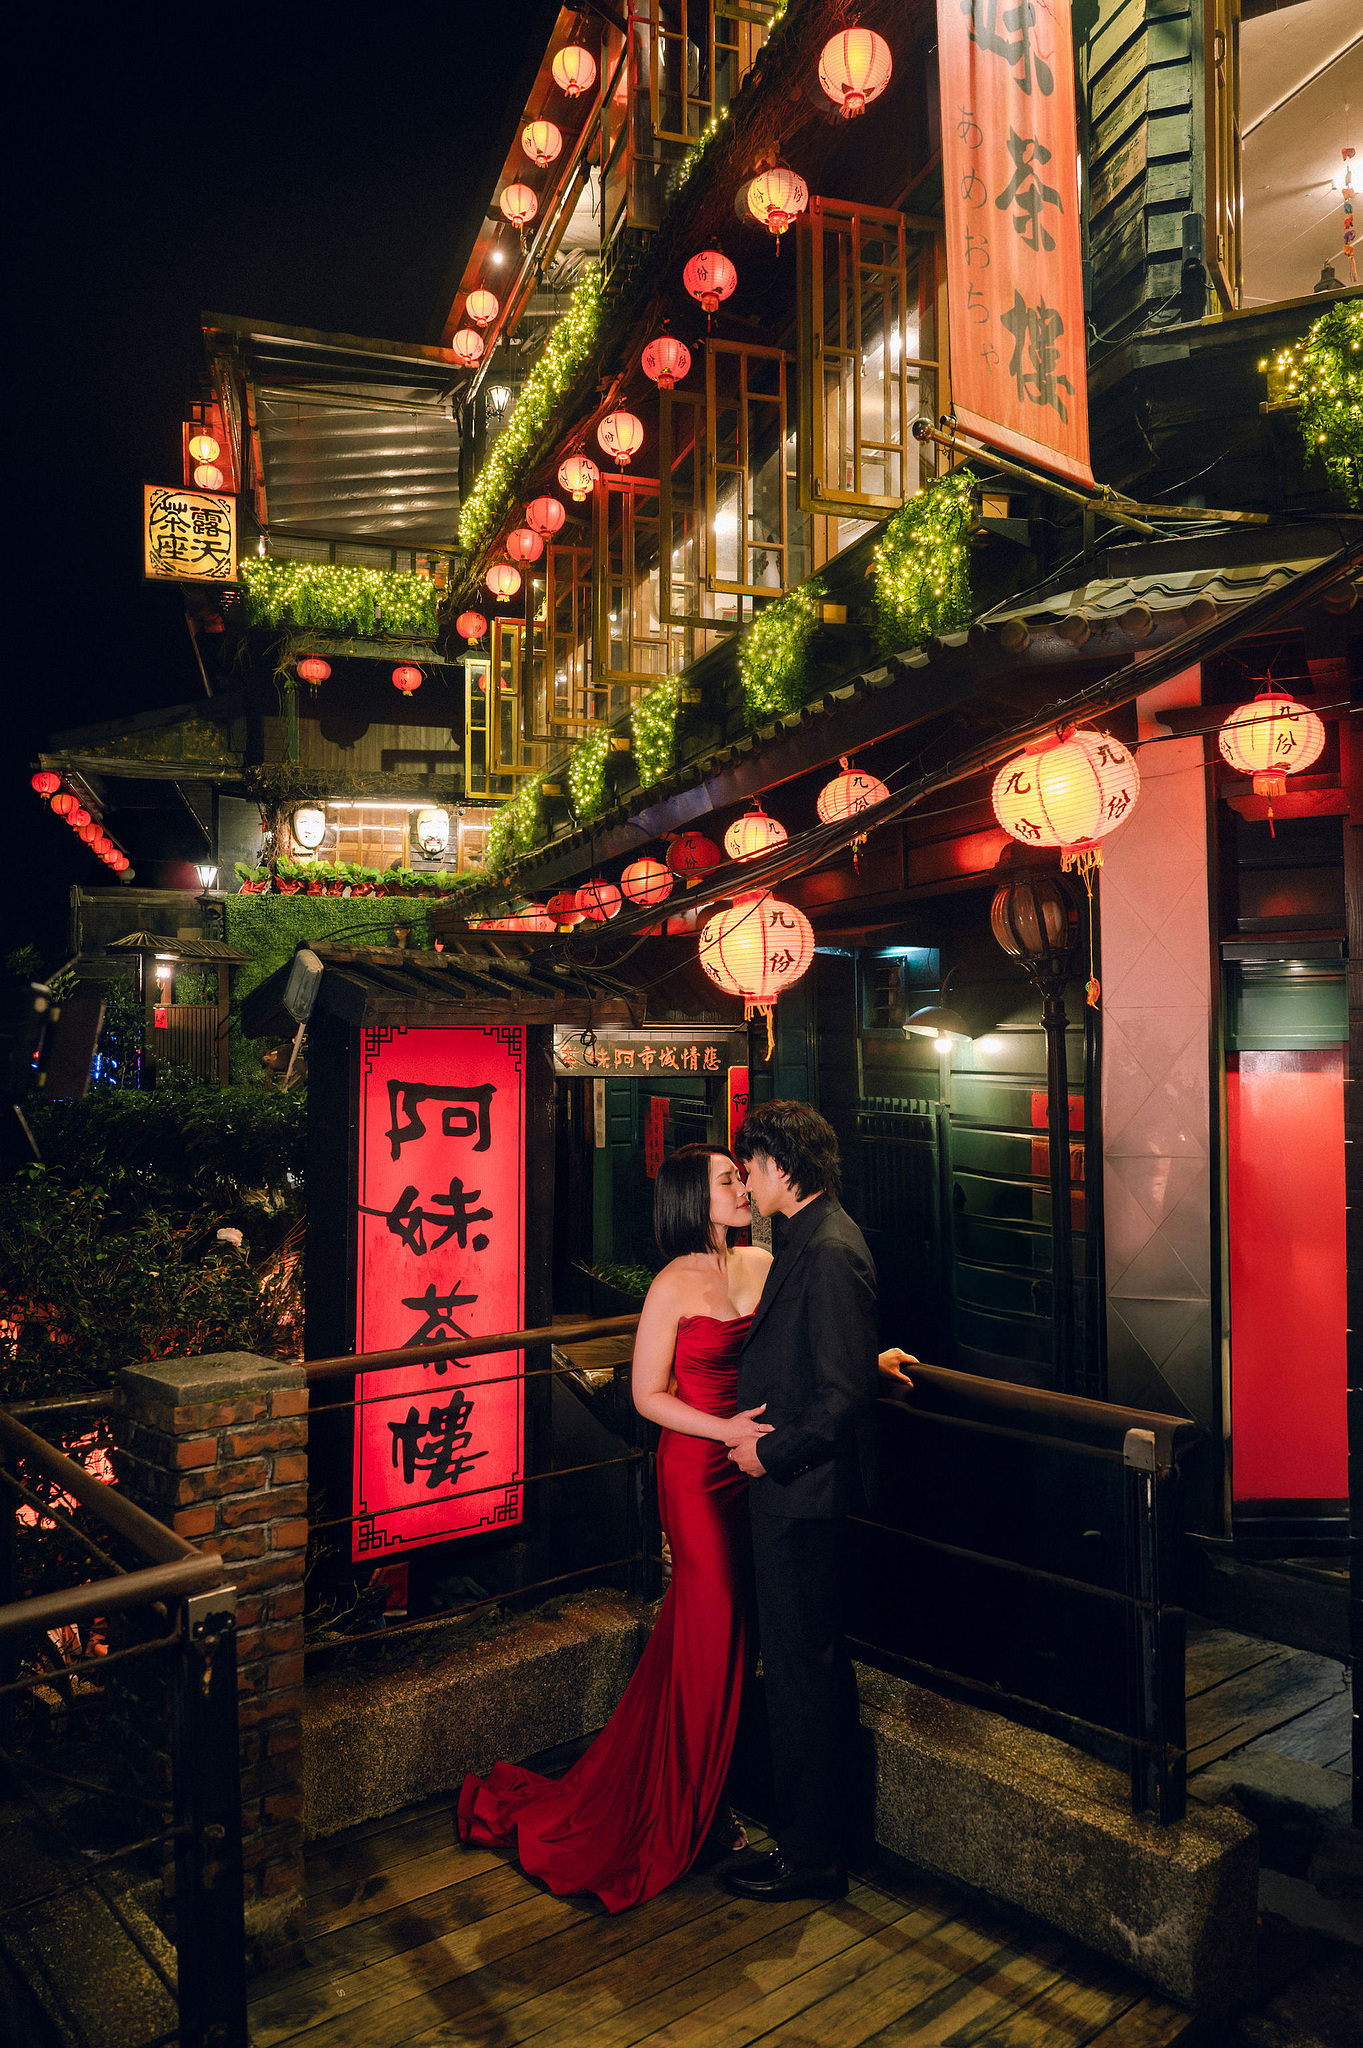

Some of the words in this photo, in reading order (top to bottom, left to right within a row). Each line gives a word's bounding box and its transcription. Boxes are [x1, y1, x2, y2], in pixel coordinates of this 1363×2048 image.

[1003, 771, 1042, 840] 九份
[1097, 744, 1132, 820] 九份
[769, 911, 796, 973] 九份
[358, 1078, 498, 1489] 阿妹茶樓
